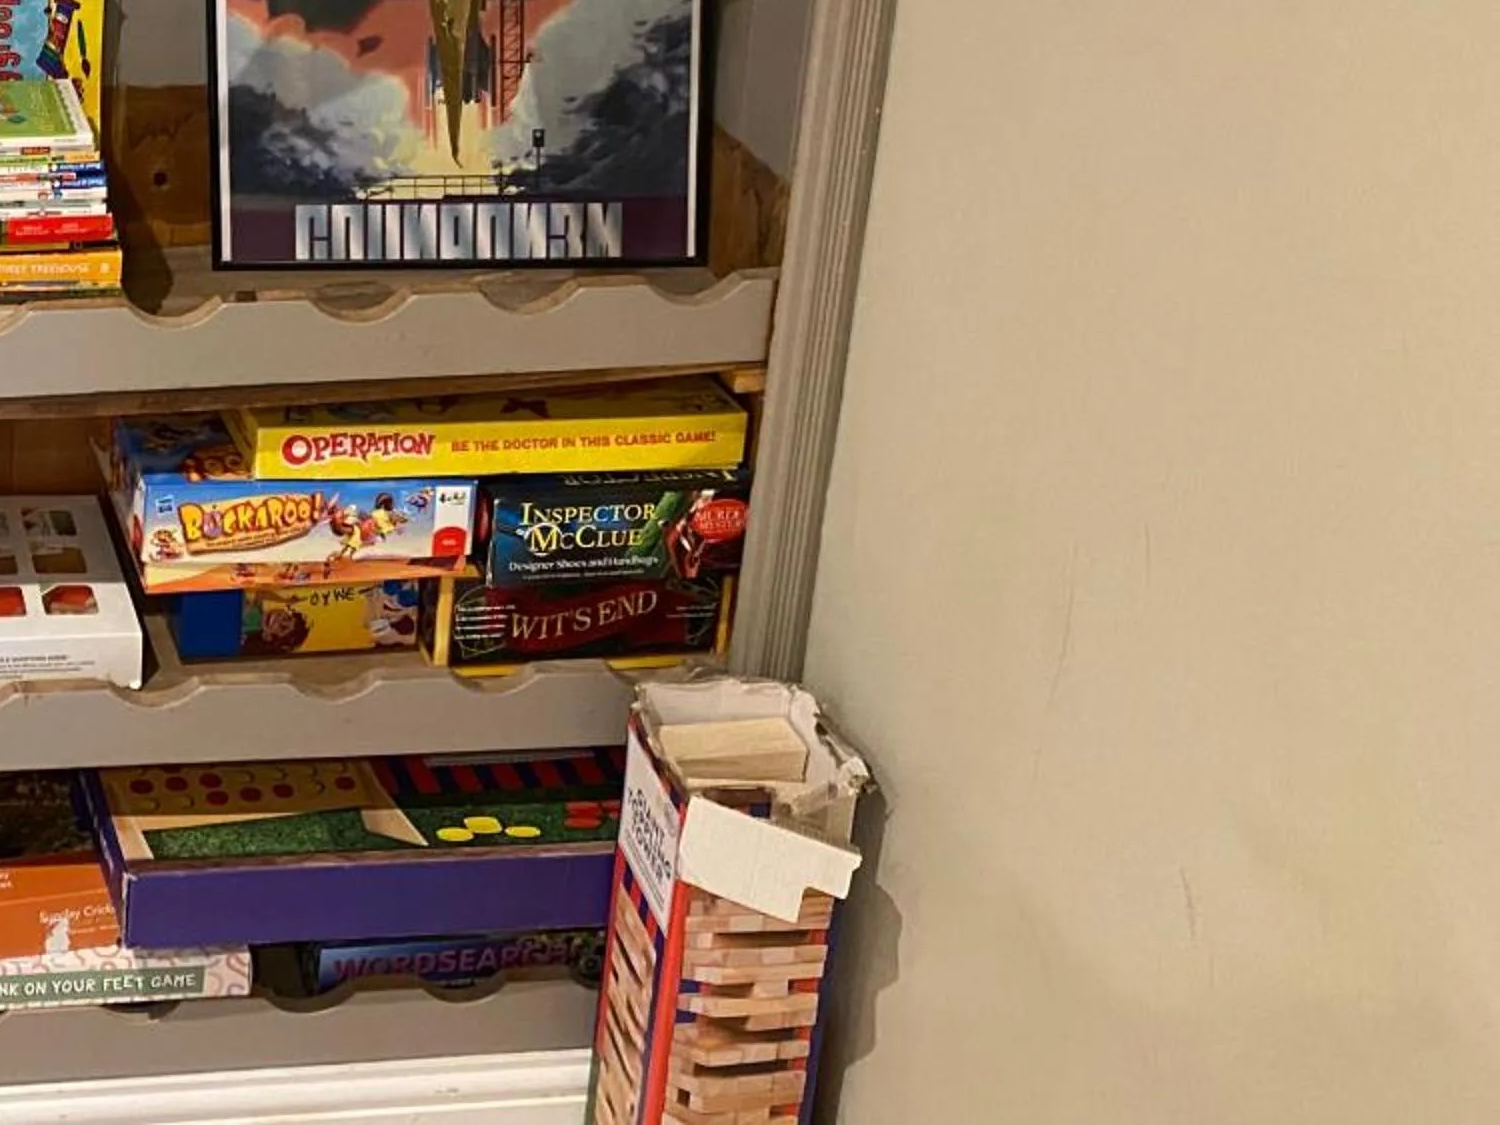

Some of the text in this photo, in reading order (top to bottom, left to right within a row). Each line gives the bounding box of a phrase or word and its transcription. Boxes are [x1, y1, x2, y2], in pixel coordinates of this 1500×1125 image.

[281, 432, 436, 465] OPERATION
[452, 431, 716, 452] BE THE DOCTOR IN THIS CLASSIC GAME!
[178, 493, 325, 542] BUCKAROO!
[520, 502, 658, 526] INSPECTOR
[509, 561, 554, 572] Designer
[556, 559, 586, 570] Shoes
[512, 590, 657, 641] WIT'S END
[24, 982, 44, 996] ON
[48, 979, 96, 994] YOUR
[103, 976, 144, 992] FEET
[150, 973, 196, 990] GAME
